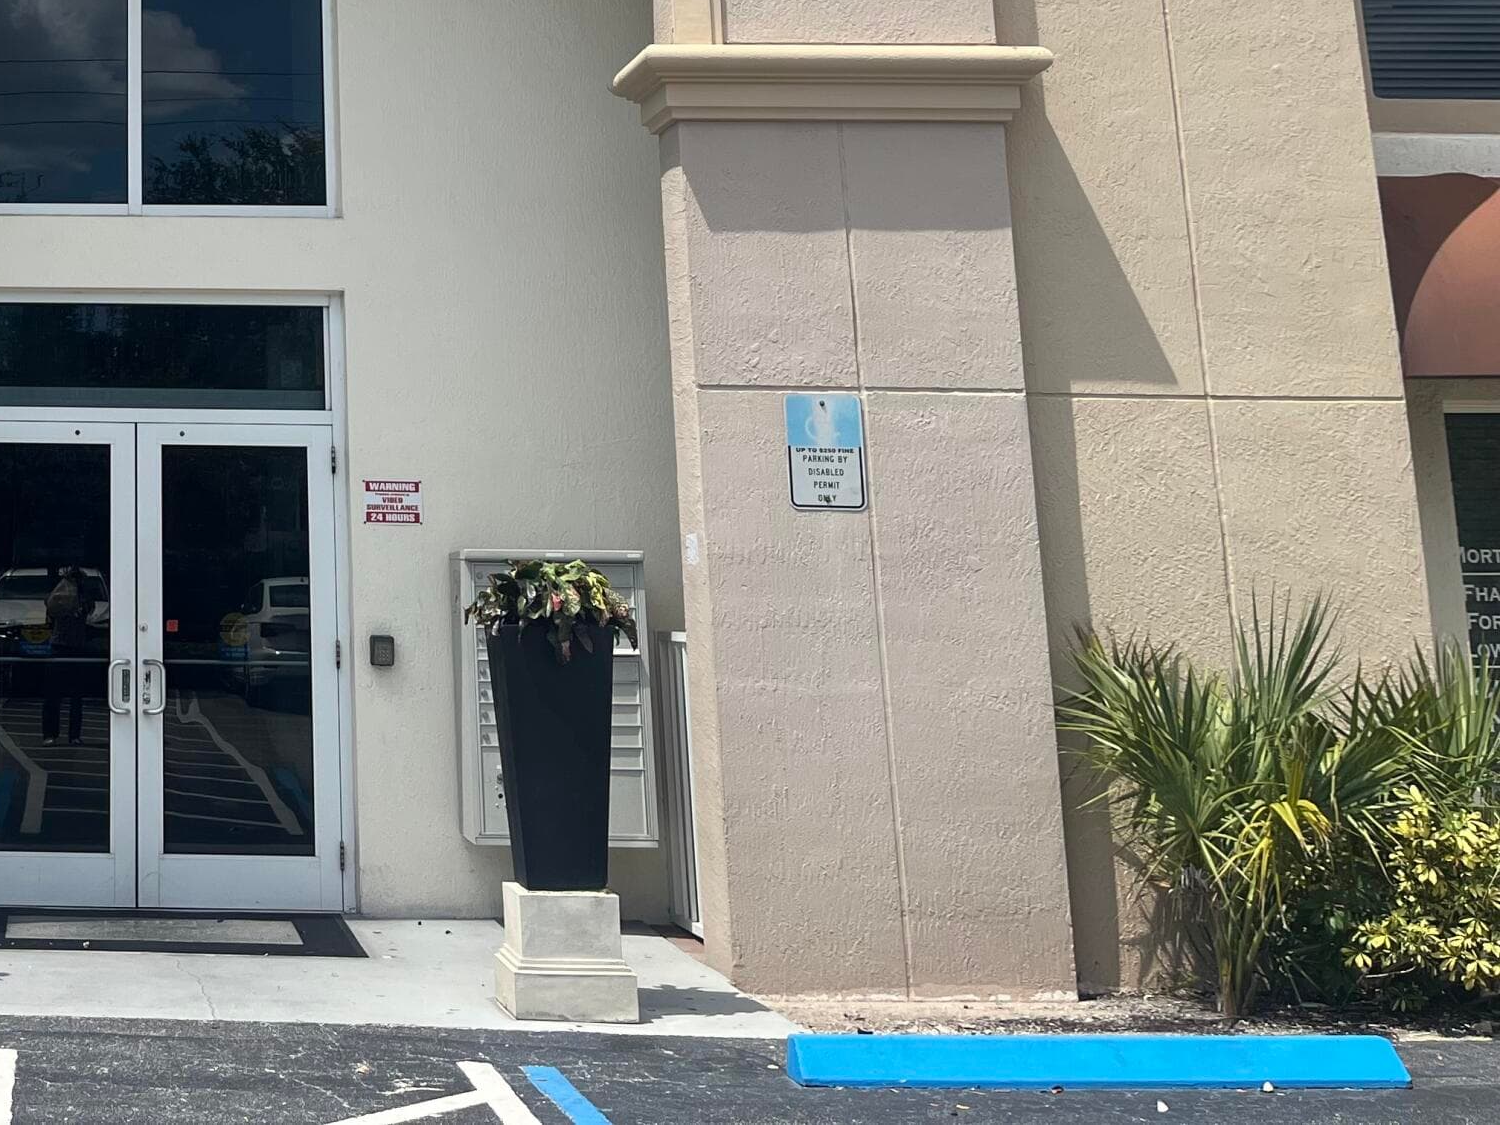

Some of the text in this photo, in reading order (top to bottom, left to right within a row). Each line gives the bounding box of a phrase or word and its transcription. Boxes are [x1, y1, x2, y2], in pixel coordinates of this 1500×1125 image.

[802, 455, 835, 463] PARKING
[808, 468, 844, 476] DISABLED
[368, 482, 416, 492] WARNING
[813, 481, 840, 489] PERMIT
[370, 513, 415, 522] 24 HOURS
